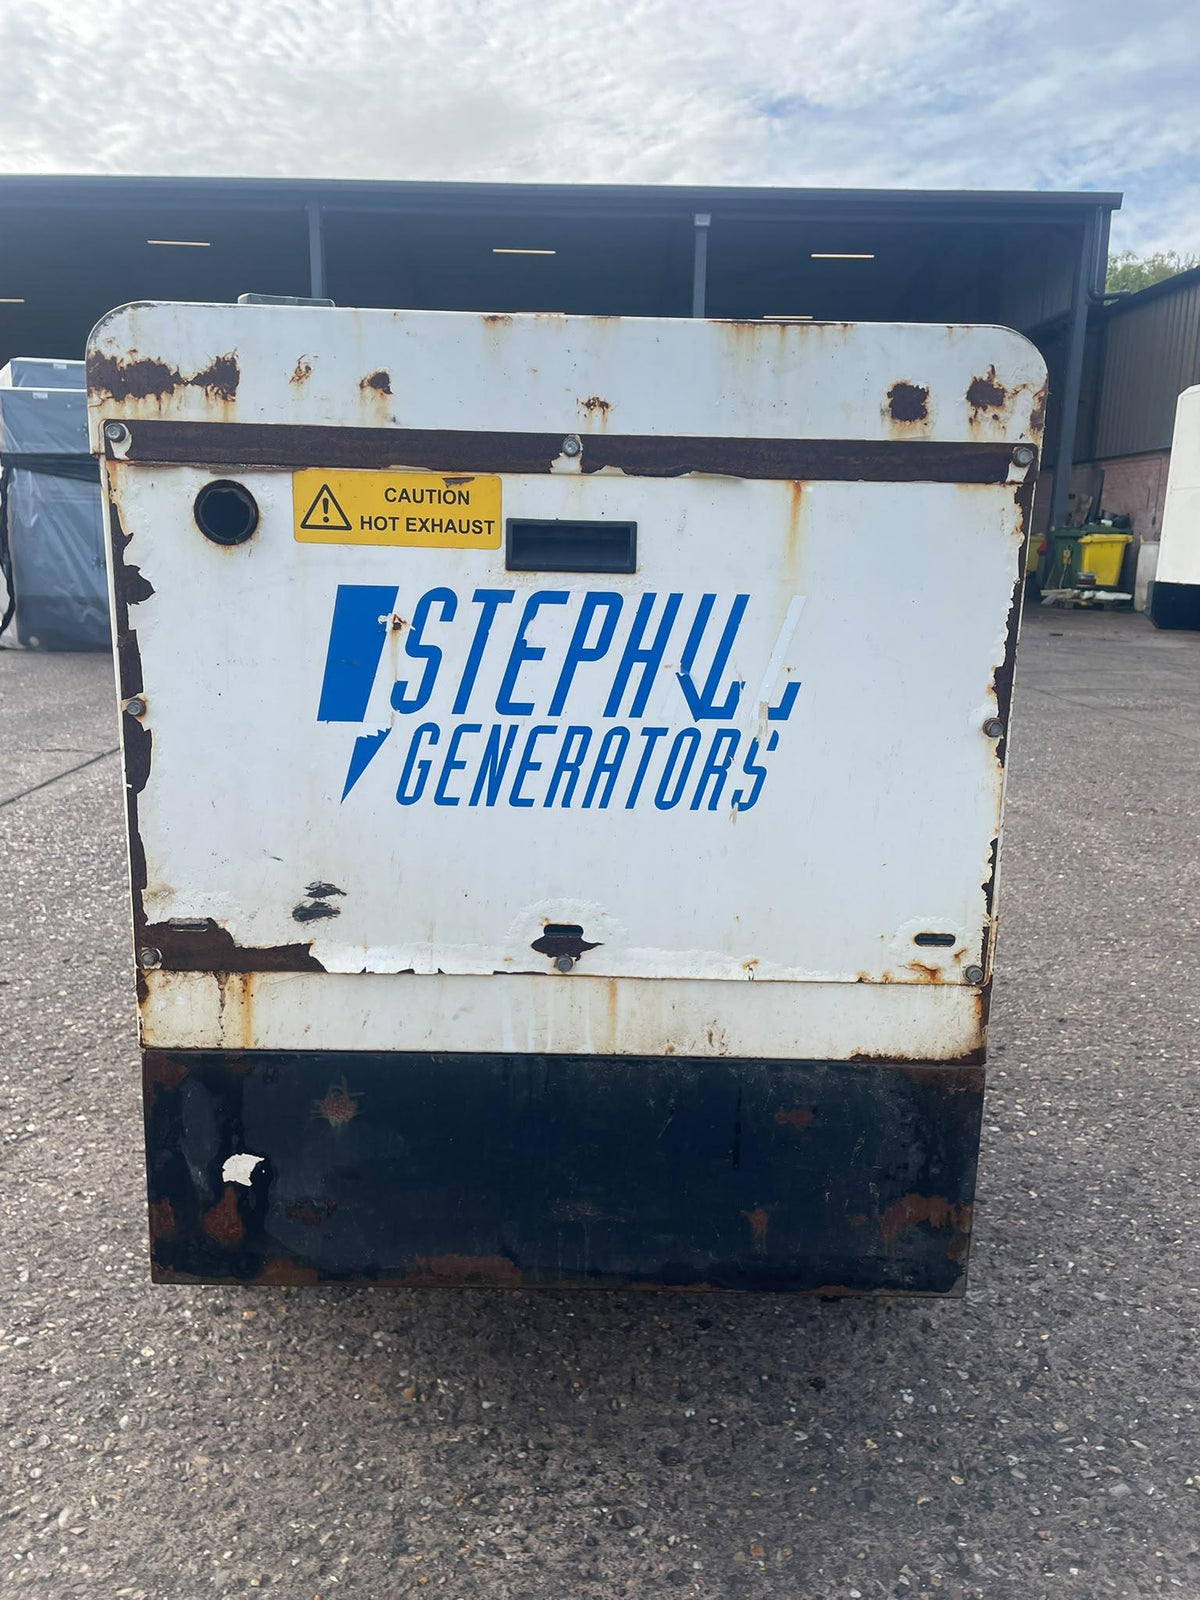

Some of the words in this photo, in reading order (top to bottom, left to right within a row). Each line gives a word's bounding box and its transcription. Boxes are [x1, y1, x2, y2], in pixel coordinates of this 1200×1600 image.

[383, 486, 470, 506] CAUTION
[360, 515, 400, 532] HOT
[405, 516, 496, 536] EXHAUST
[395, 721, 780, 813] GENERATORS
